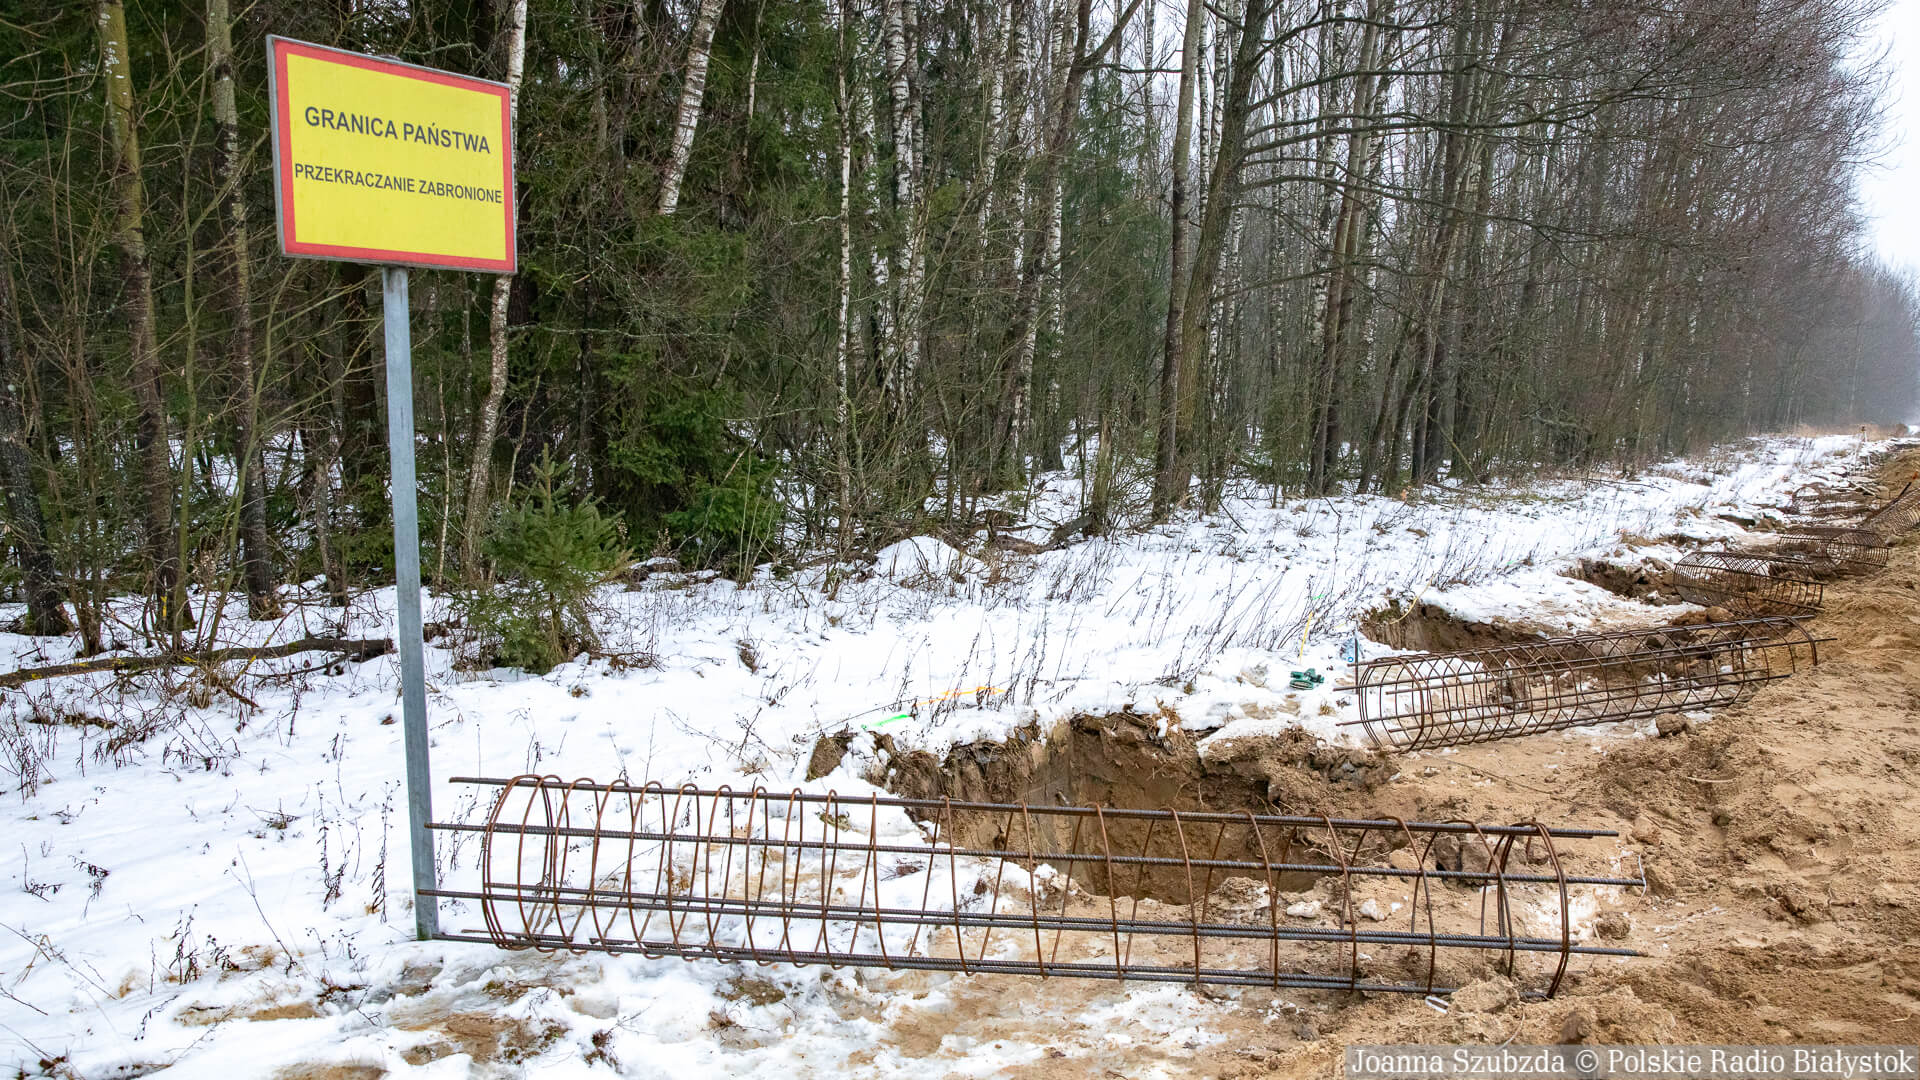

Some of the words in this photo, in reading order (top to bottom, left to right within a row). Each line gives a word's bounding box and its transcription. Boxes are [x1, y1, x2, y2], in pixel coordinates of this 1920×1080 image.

[304, 106, 398, 140] GRANICA
[403, 122, 491, 154] PAŃSTWA
[295, 163, 415, 193] PRZEKRACZANIE
[419, 179, 503, 204] ZABRONIONE
